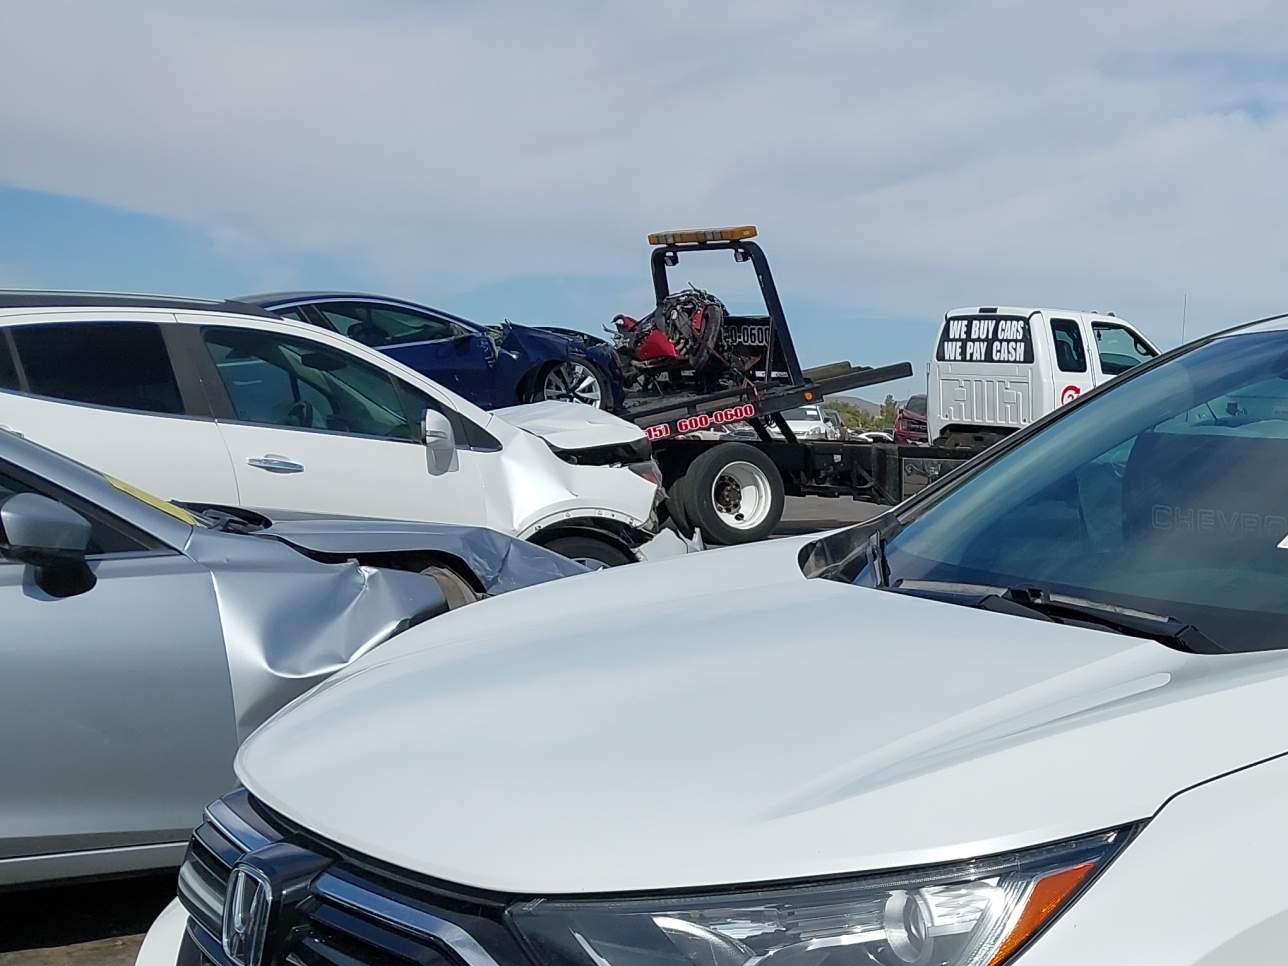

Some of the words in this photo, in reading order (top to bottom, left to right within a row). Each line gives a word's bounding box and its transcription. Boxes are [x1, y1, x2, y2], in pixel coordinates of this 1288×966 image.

[949, 320, 968, 339] WE
[971, 320, 996, 339] BUY
[997, 320, 1024, 340] CARS
[944, 341, 962, 360] WE
[966, 341, 987, 360] PAY
[992, 341, 1025, 361] CASH
[677, 404, 755, 432] 600-0600
